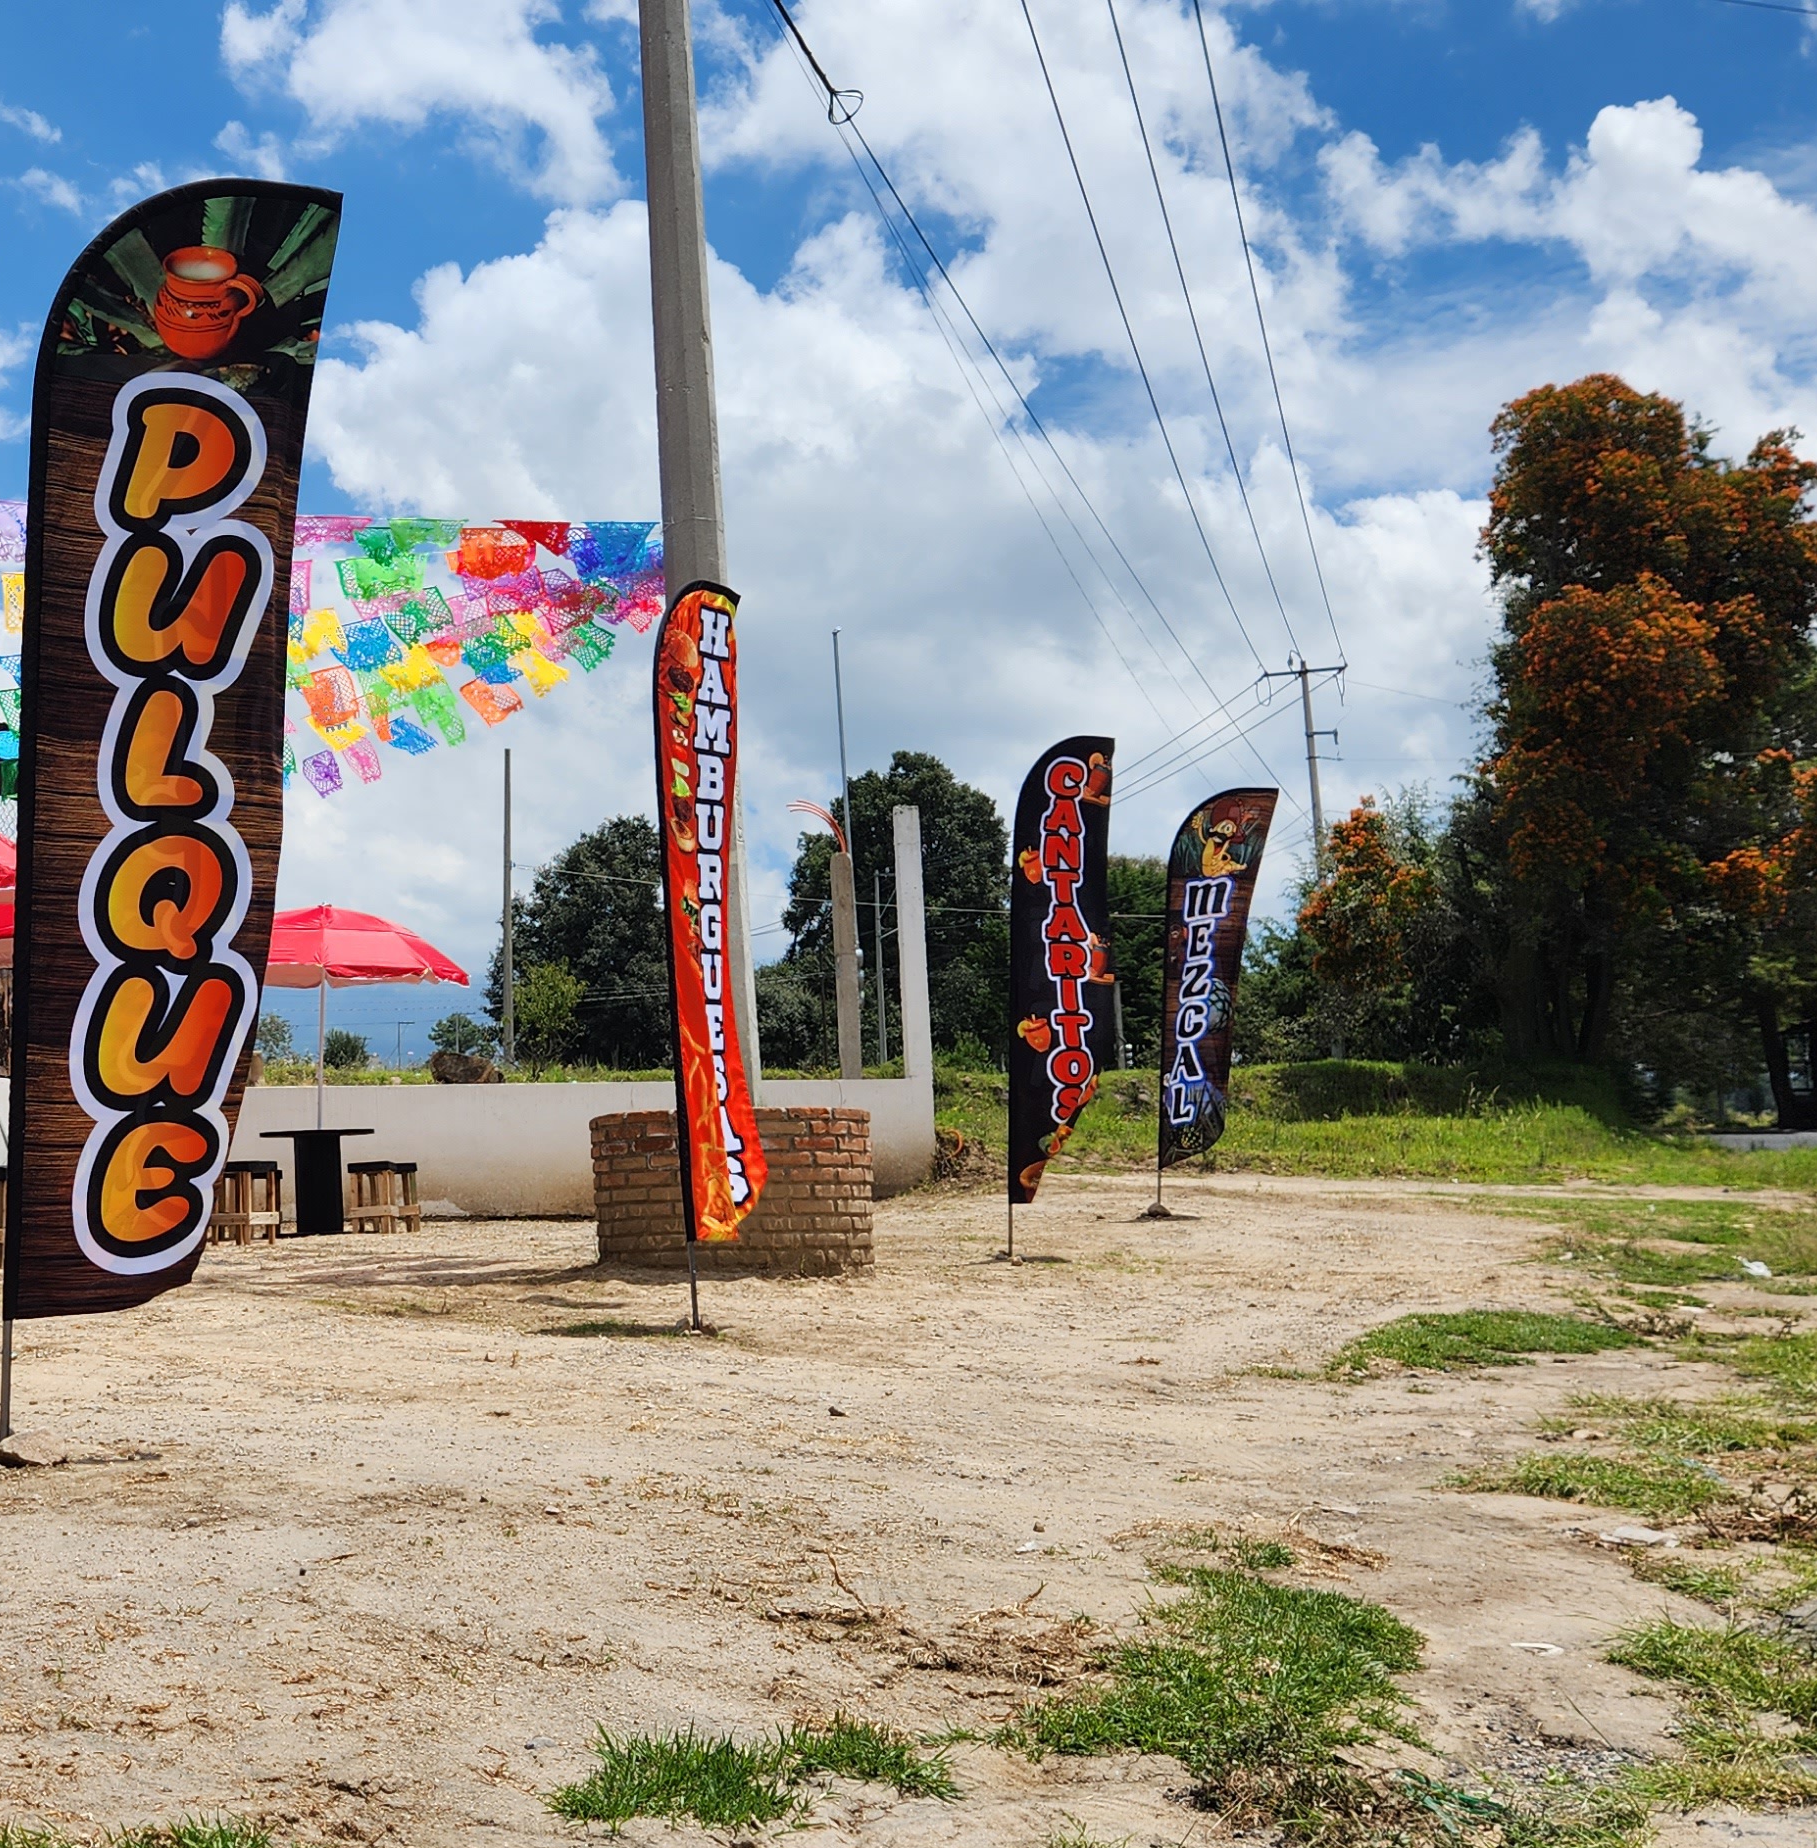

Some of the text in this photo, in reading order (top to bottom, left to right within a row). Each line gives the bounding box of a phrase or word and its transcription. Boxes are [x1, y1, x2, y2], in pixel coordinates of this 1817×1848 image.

[71, 372, 274, 1274] PULQUE
[1041, 757, 1092, 1124] CANTARITOS
[1169, 877, 1233, 1126] MEZCAL
